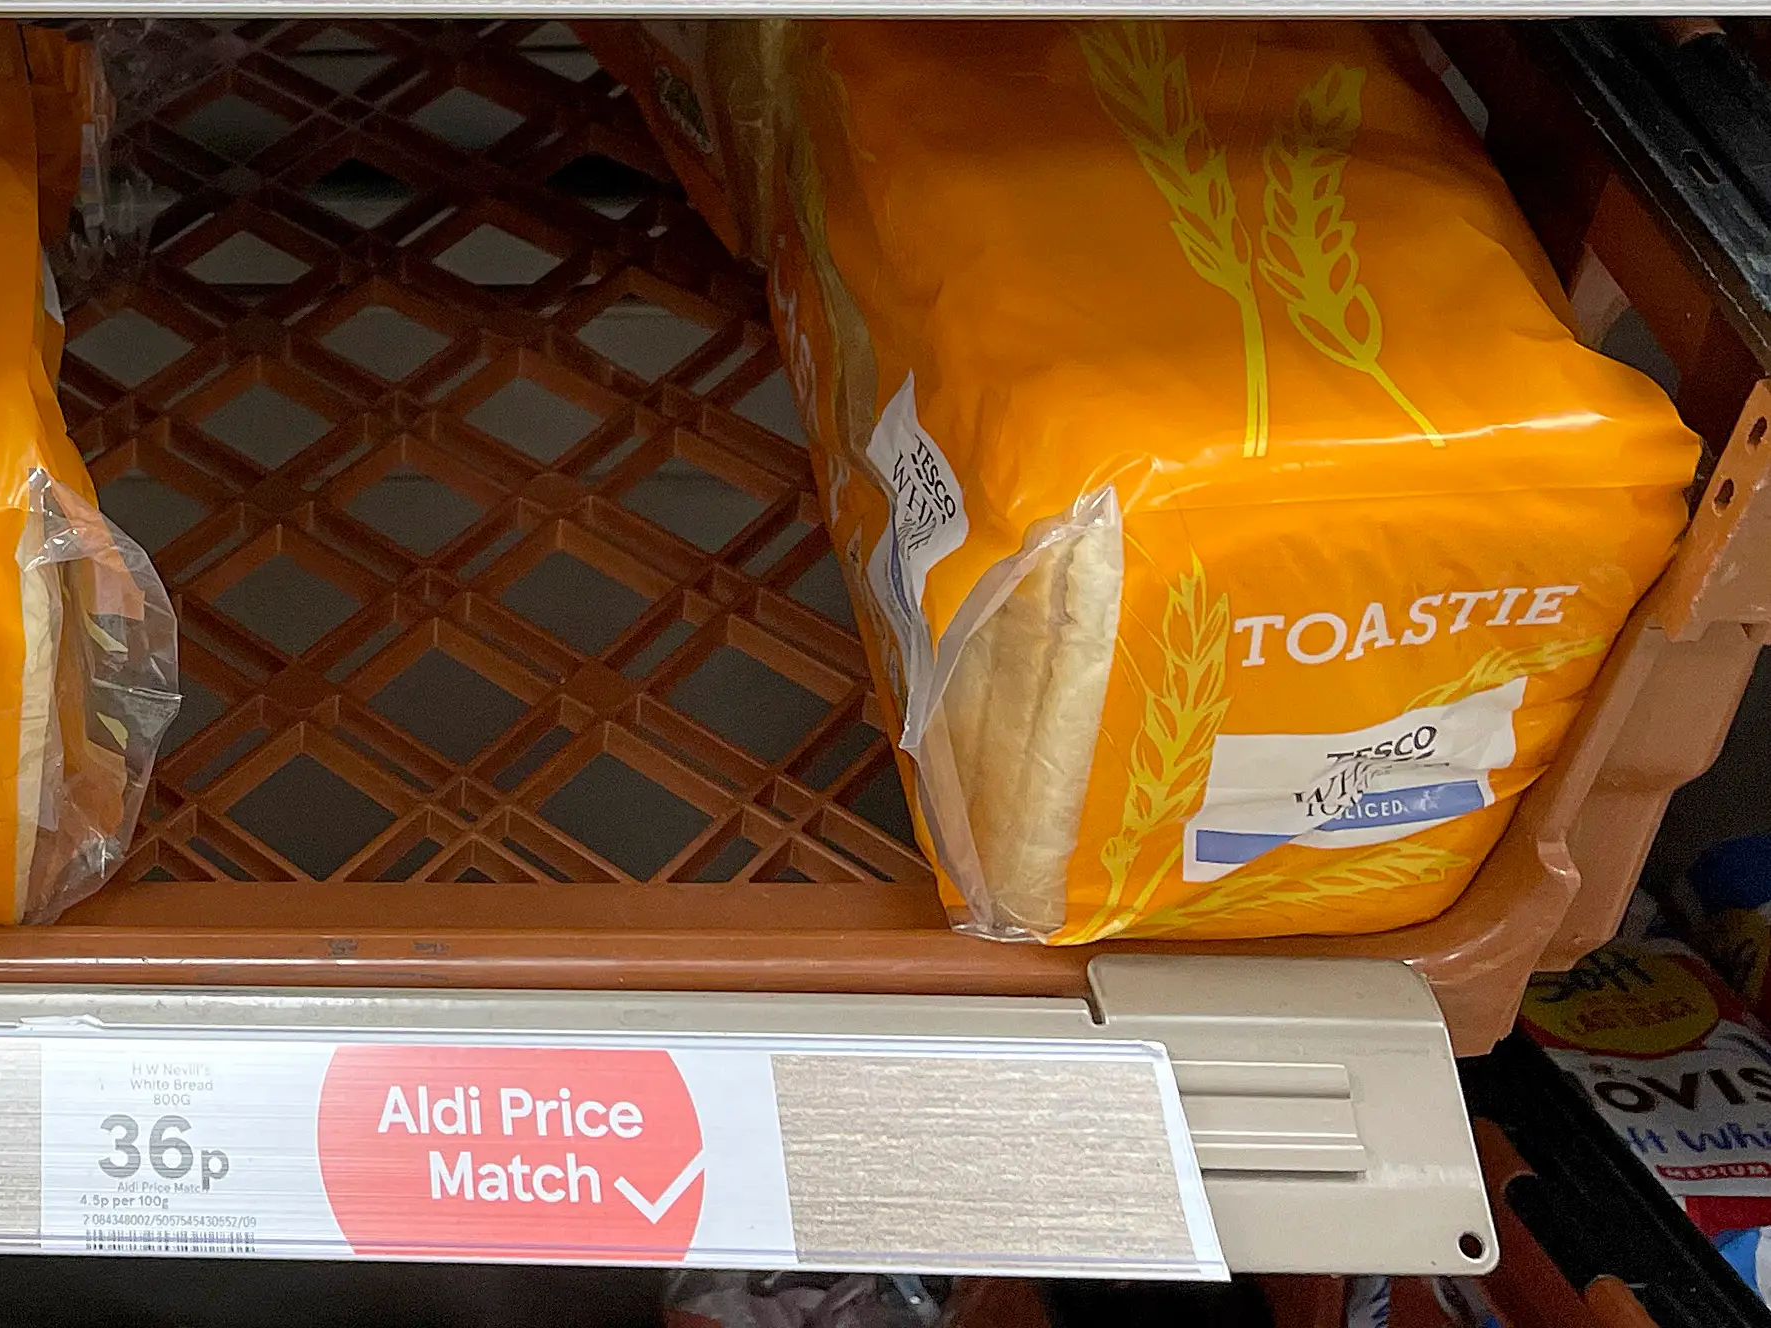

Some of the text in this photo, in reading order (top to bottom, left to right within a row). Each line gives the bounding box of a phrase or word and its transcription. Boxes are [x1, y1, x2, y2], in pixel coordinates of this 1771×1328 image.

[914, 433, 957, 520] TESCO
[1233, 584, 1580, 668] TOASTIE
[129, 1078, 214, 1092] White Bread
[153, 1093, 192, 1106] 800G
[377, 1085, 644, 1139] Aldi Price
[97, 1113, 230, 1192] 36p
[429, 1149, 602, 1204] Match
[79, 1194, 170, 1210] 4.5p per 100g
[117, 1181, 208, 1194] Aldi Price Matc
